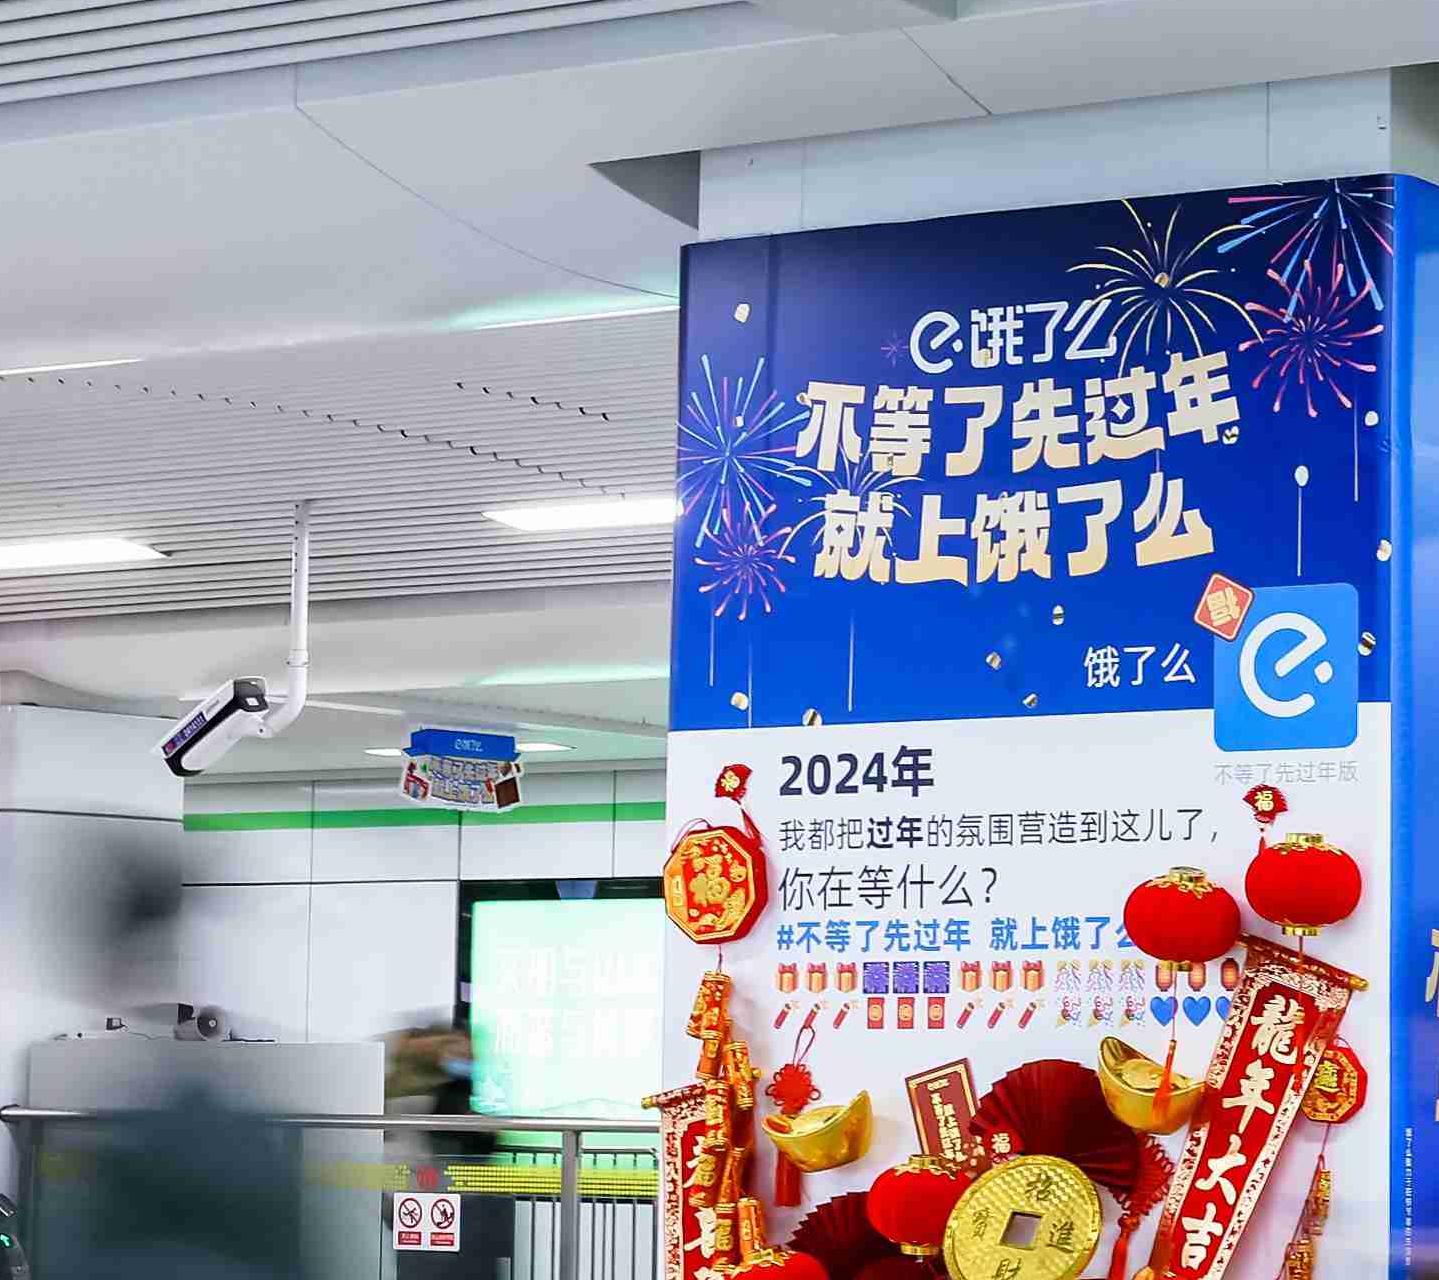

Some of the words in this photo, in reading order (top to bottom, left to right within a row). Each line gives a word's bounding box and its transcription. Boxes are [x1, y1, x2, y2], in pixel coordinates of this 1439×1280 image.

[796, 353, 1240, 478] 不等了先过年
[814, 472, 1215, 587] 就上饿了么
[1084, 644, 1197, 690] 饿了么
[778, 746, 935, 799] 2024年
[1213, 760, 1361, 785] 不等了先过年版
[777, 920, 971, 954] #不等了先过年
[1182, 994, 1304, 1270] 龍年大吉
